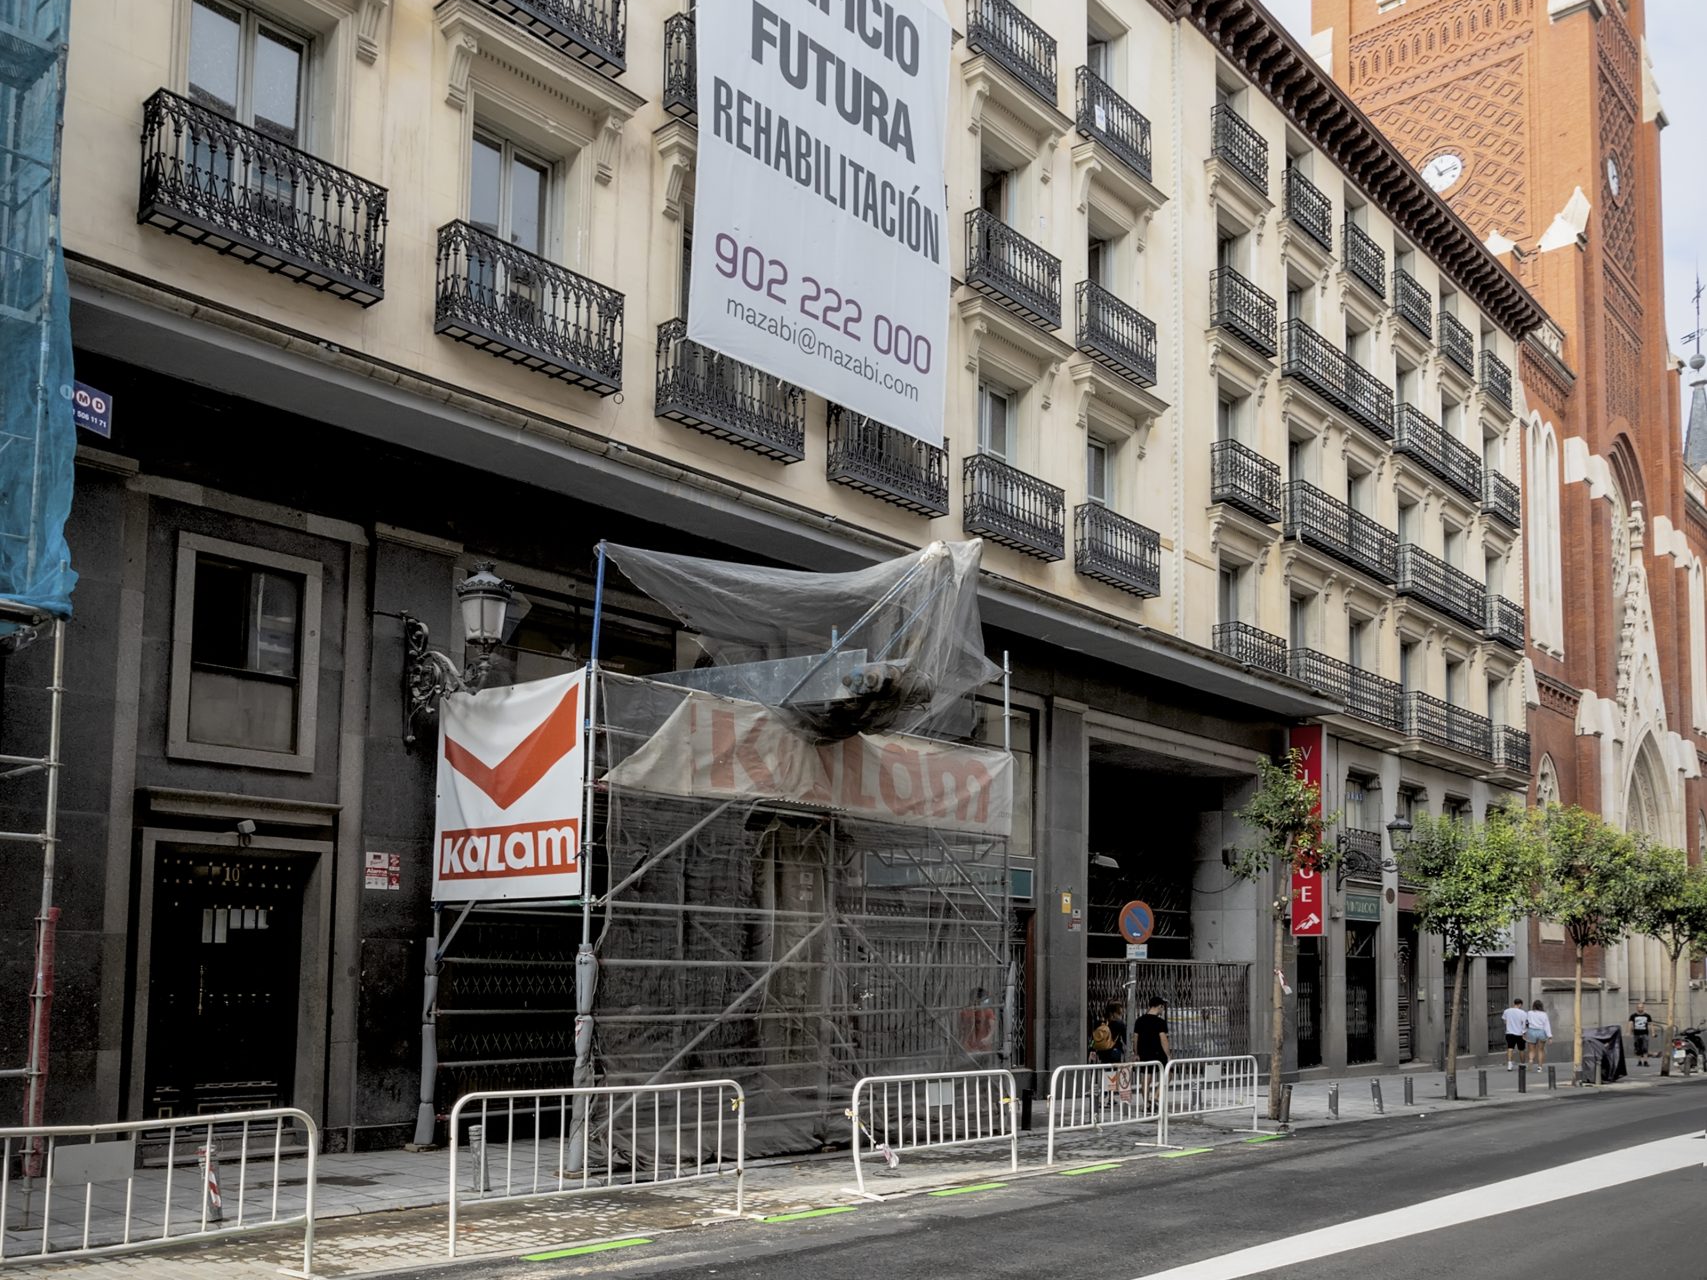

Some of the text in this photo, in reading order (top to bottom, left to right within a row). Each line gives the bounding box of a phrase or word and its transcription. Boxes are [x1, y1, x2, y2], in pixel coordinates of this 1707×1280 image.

[713, 75, 940, 265] REHABILITACIÓN
[715, 232, 931, 375] 902 222 000
[726, 297, 919, 402] mazabi@mazabi.com
[225, 867, 240, 881] 10
